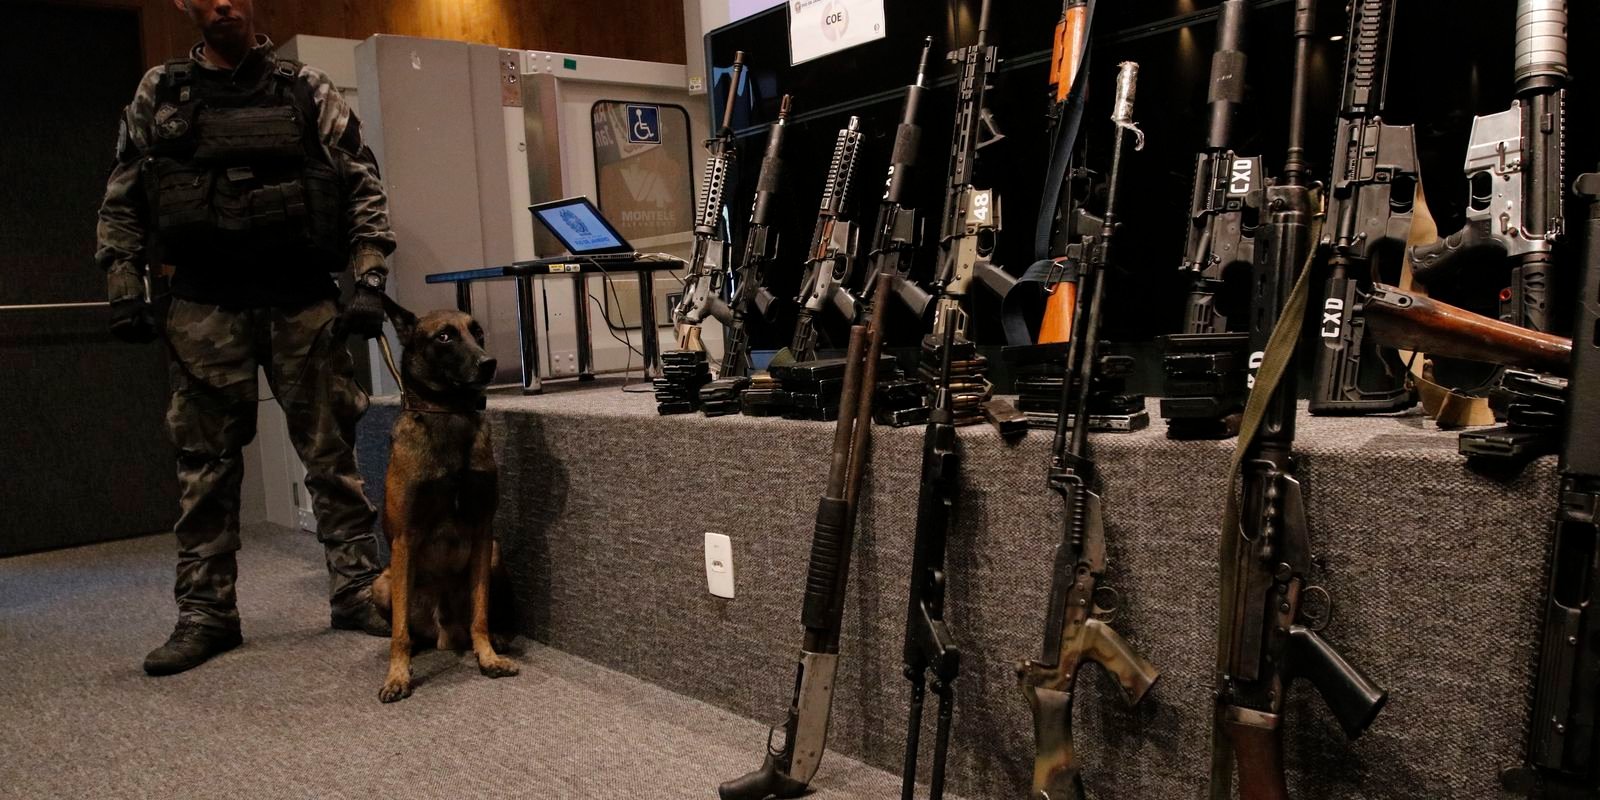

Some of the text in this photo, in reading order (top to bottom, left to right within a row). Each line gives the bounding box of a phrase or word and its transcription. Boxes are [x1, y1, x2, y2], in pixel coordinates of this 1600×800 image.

[825, 12, 842, 26] COE
[1230, 159, 1252, 194] CXD
[621, 211, 675, 222] MONTELE
[973, 193, 989, 221] 48
[1321, 297, 1344, 338] CXD
